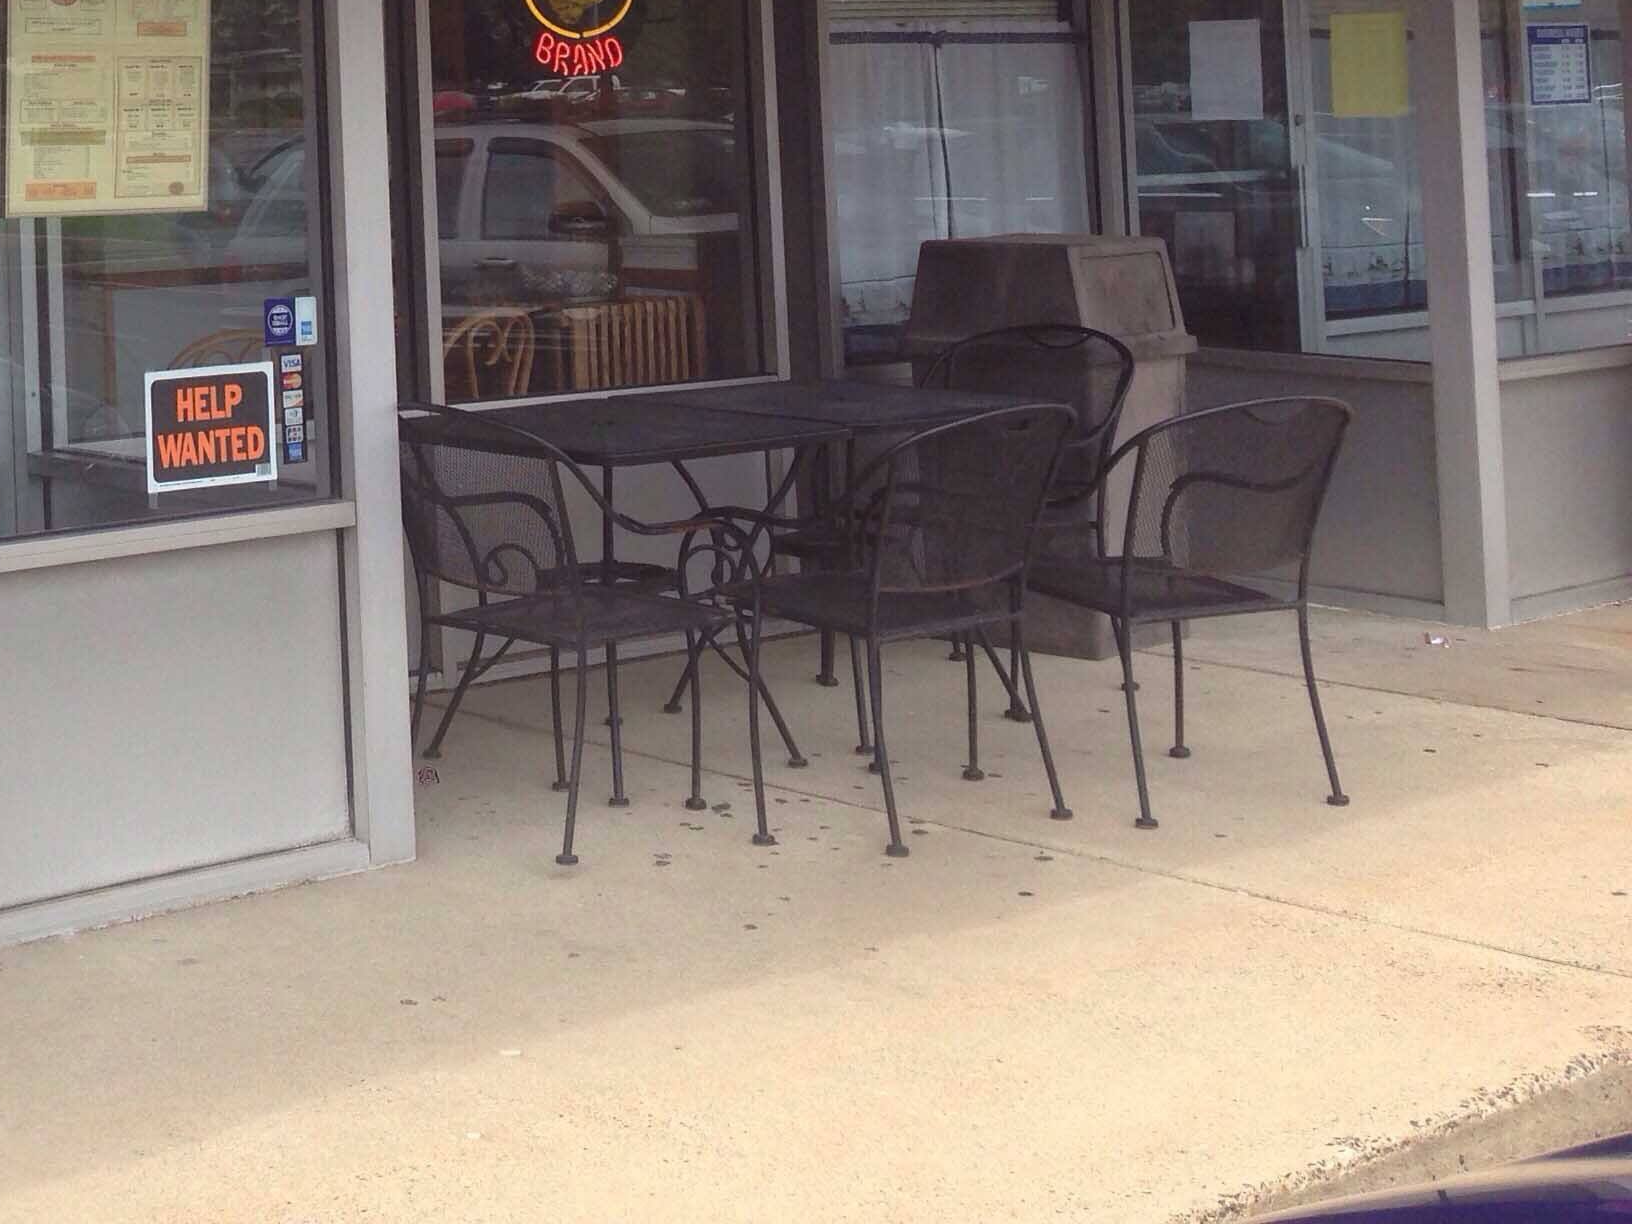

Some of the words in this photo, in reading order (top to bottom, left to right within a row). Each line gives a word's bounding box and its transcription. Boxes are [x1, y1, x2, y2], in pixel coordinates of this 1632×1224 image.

[536, 33, 623, 76] BRAND
[283, 359, 302, 369] VISA
[176, 384, 243, 422] HELP
[157, 426, 265, 468] WANTED
